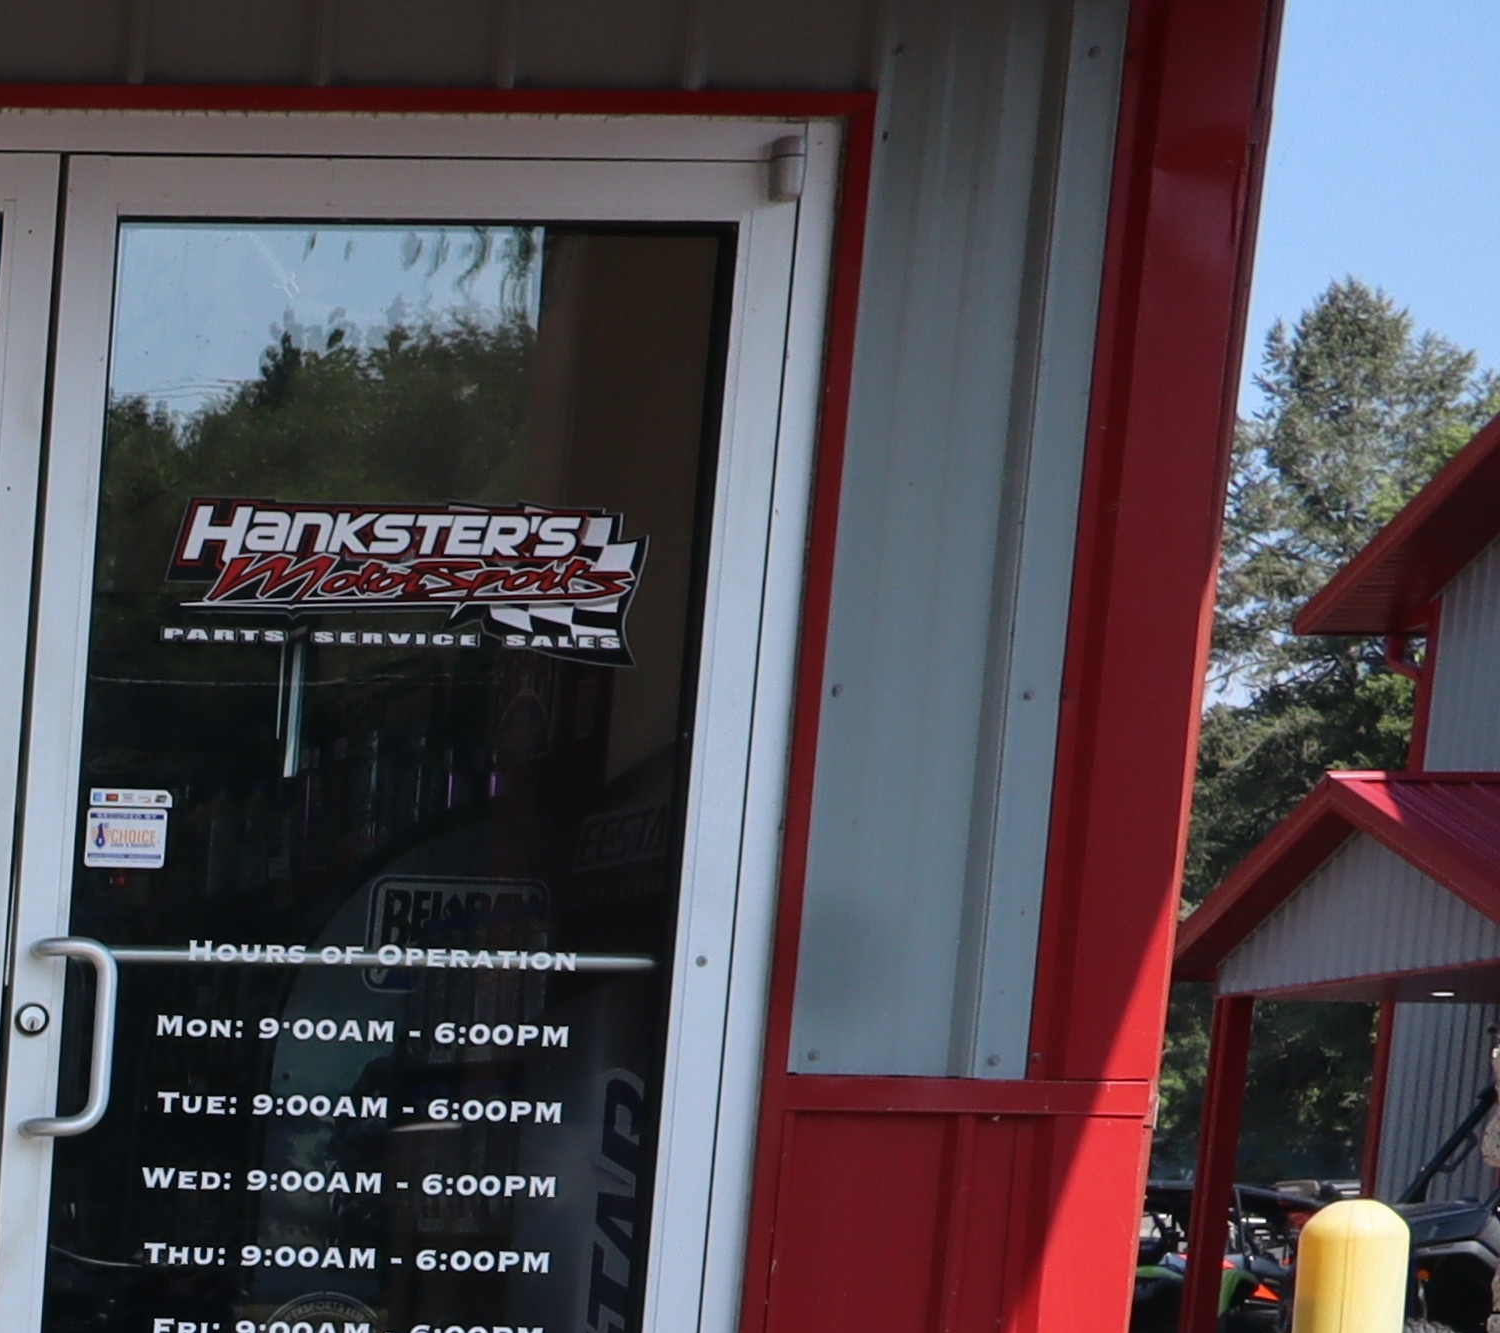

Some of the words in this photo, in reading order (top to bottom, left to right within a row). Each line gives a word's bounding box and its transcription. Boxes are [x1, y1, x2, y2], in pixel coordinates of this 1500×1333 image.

[162, 626, 286, 643] PARTS
[311, 631, 479, 648] SERVICE
[505, 633, 621, 650] SALES
[111, 829, 156, 843] CHOICE
[188, 939, 306, 964] HOURS
[320, 945, 362, 965] OF
[378, 945, 577, 971] OPERATION
[156, 1015, 245, 1040] MON:
[258, 1017, 395, 1043] 9:00AM
[433, 1021, 570, 1048] 6:00PM
[158, 1092, 238, 1117] TUE:
[252, 1094, 388, 1120] 9:00AM
[427, 1098, 563, 1125] 6:00PM
[142, 1167, 232, 1192] WED:
[245, 1169, 383, 1195] 9:00AM
[421, 1174, 557, 1200] 6:00PM
[143, 1243, 227, 1268] THU:
[240, 1245, 377, 1271] 9:00AM
[415, 1249, 551, 1275] 6:00PM
